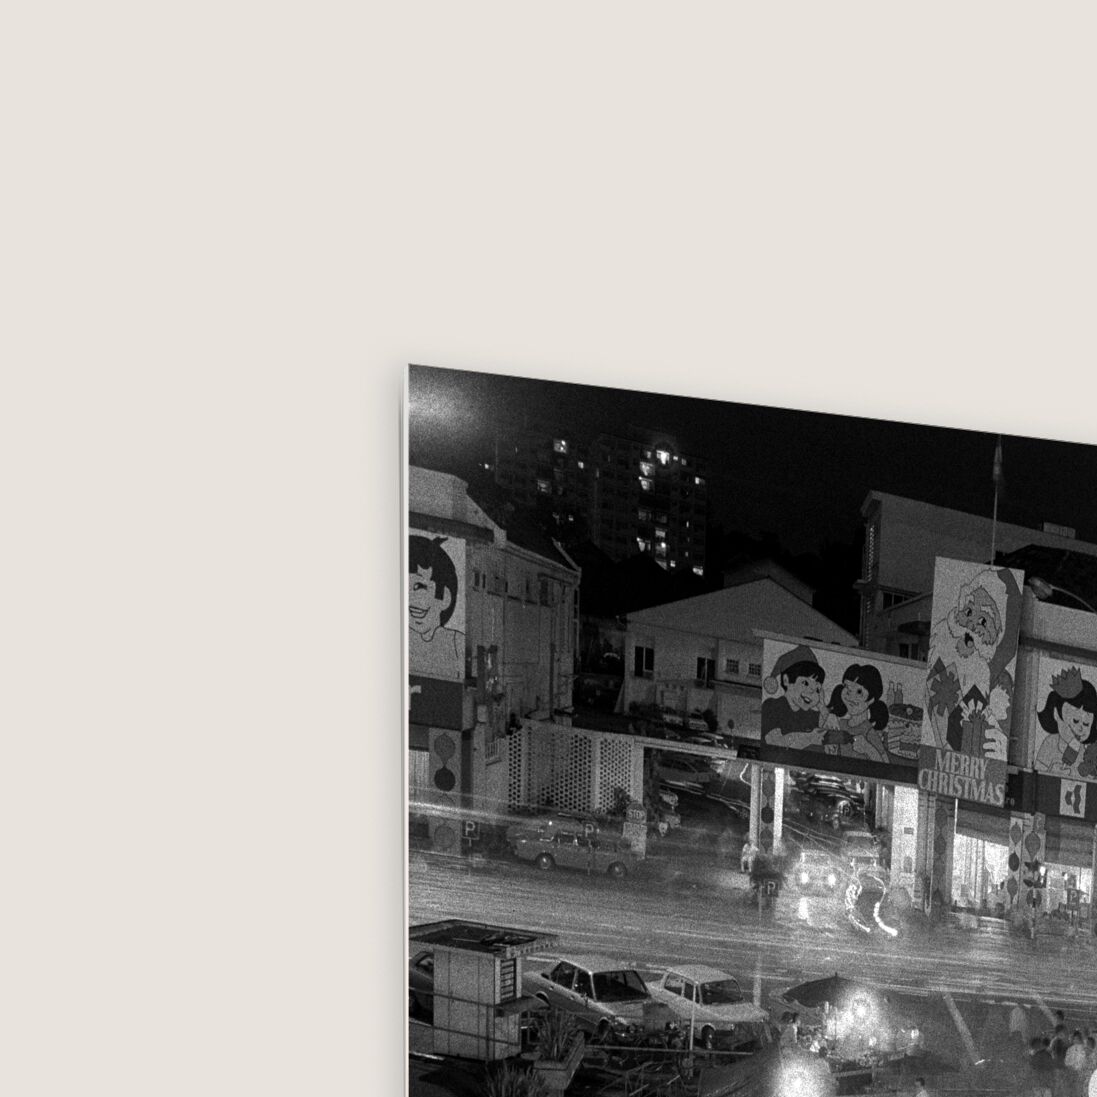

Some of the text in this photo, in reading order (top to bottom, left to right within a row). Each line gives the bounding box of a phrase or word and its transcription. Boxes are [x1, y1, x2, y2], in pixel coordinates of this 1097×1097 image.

[935, 749, 989, 780] MERRY
[918, 768, 1005, 807] CHRISTMAS
[628, 809, 646, 820] STOP
[465, 820, 476, 836] P
[585, 823, 595, 837] P
[767, 881, 776, 895] P
